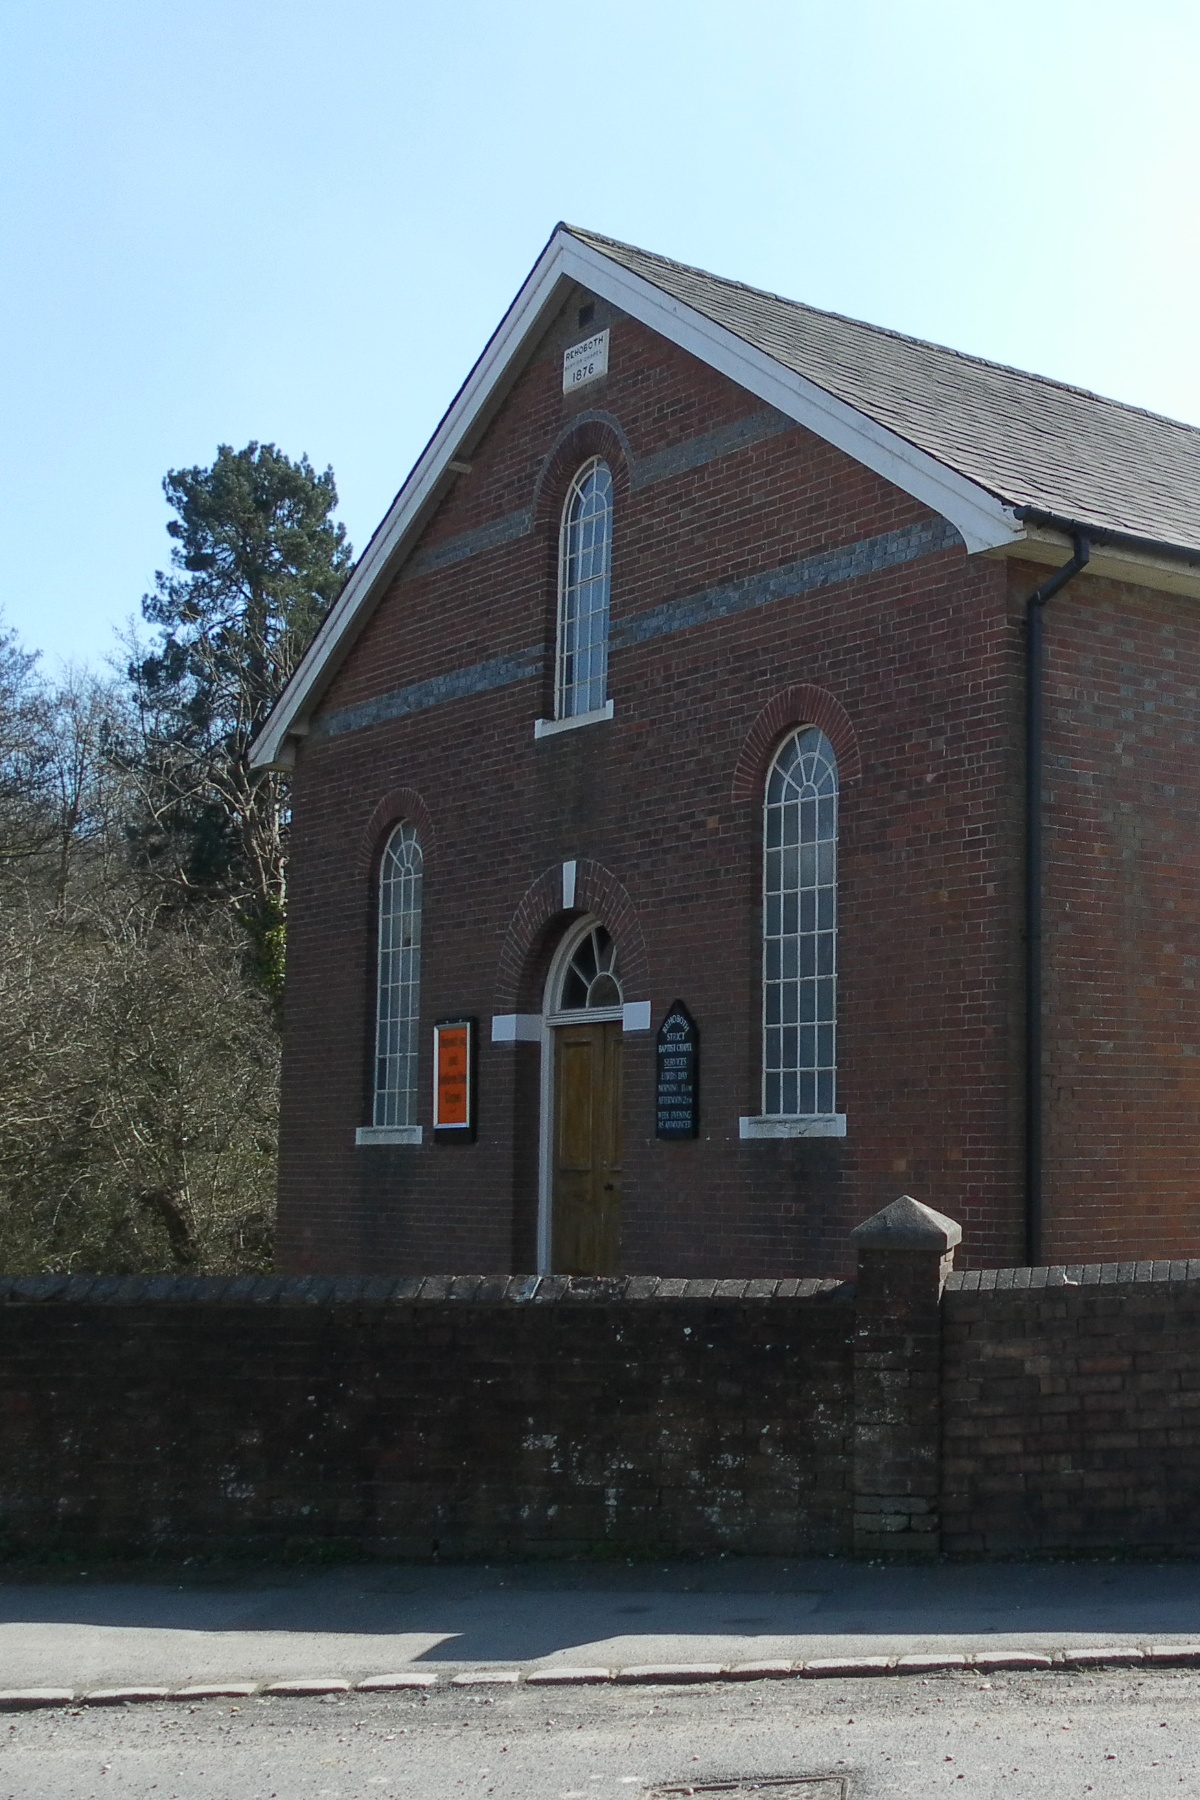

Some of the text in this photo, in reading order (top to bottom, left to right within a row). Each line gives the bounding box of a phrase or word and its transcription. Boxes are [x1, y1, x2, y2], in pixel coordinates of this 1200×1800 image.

[566, 336, 603, 361] REHOBOTH
[572, 363, 594, 382] 1876
[662, 1014, 690, 1034] REHOBOTH
[667, 1032, 685, 1041] STRICT
[658, 1043, 692, 1053] BAPTIST CHAPEL
[663, 1057, 687, 1067] SERVICES
[678, 1072, 688, 1080] DAY
[658, 1084, 678, 1092] MORNING
[658, 1096, 682, 1105] AFTERNOON
[670, 1111, 692, 1119] EVENING
